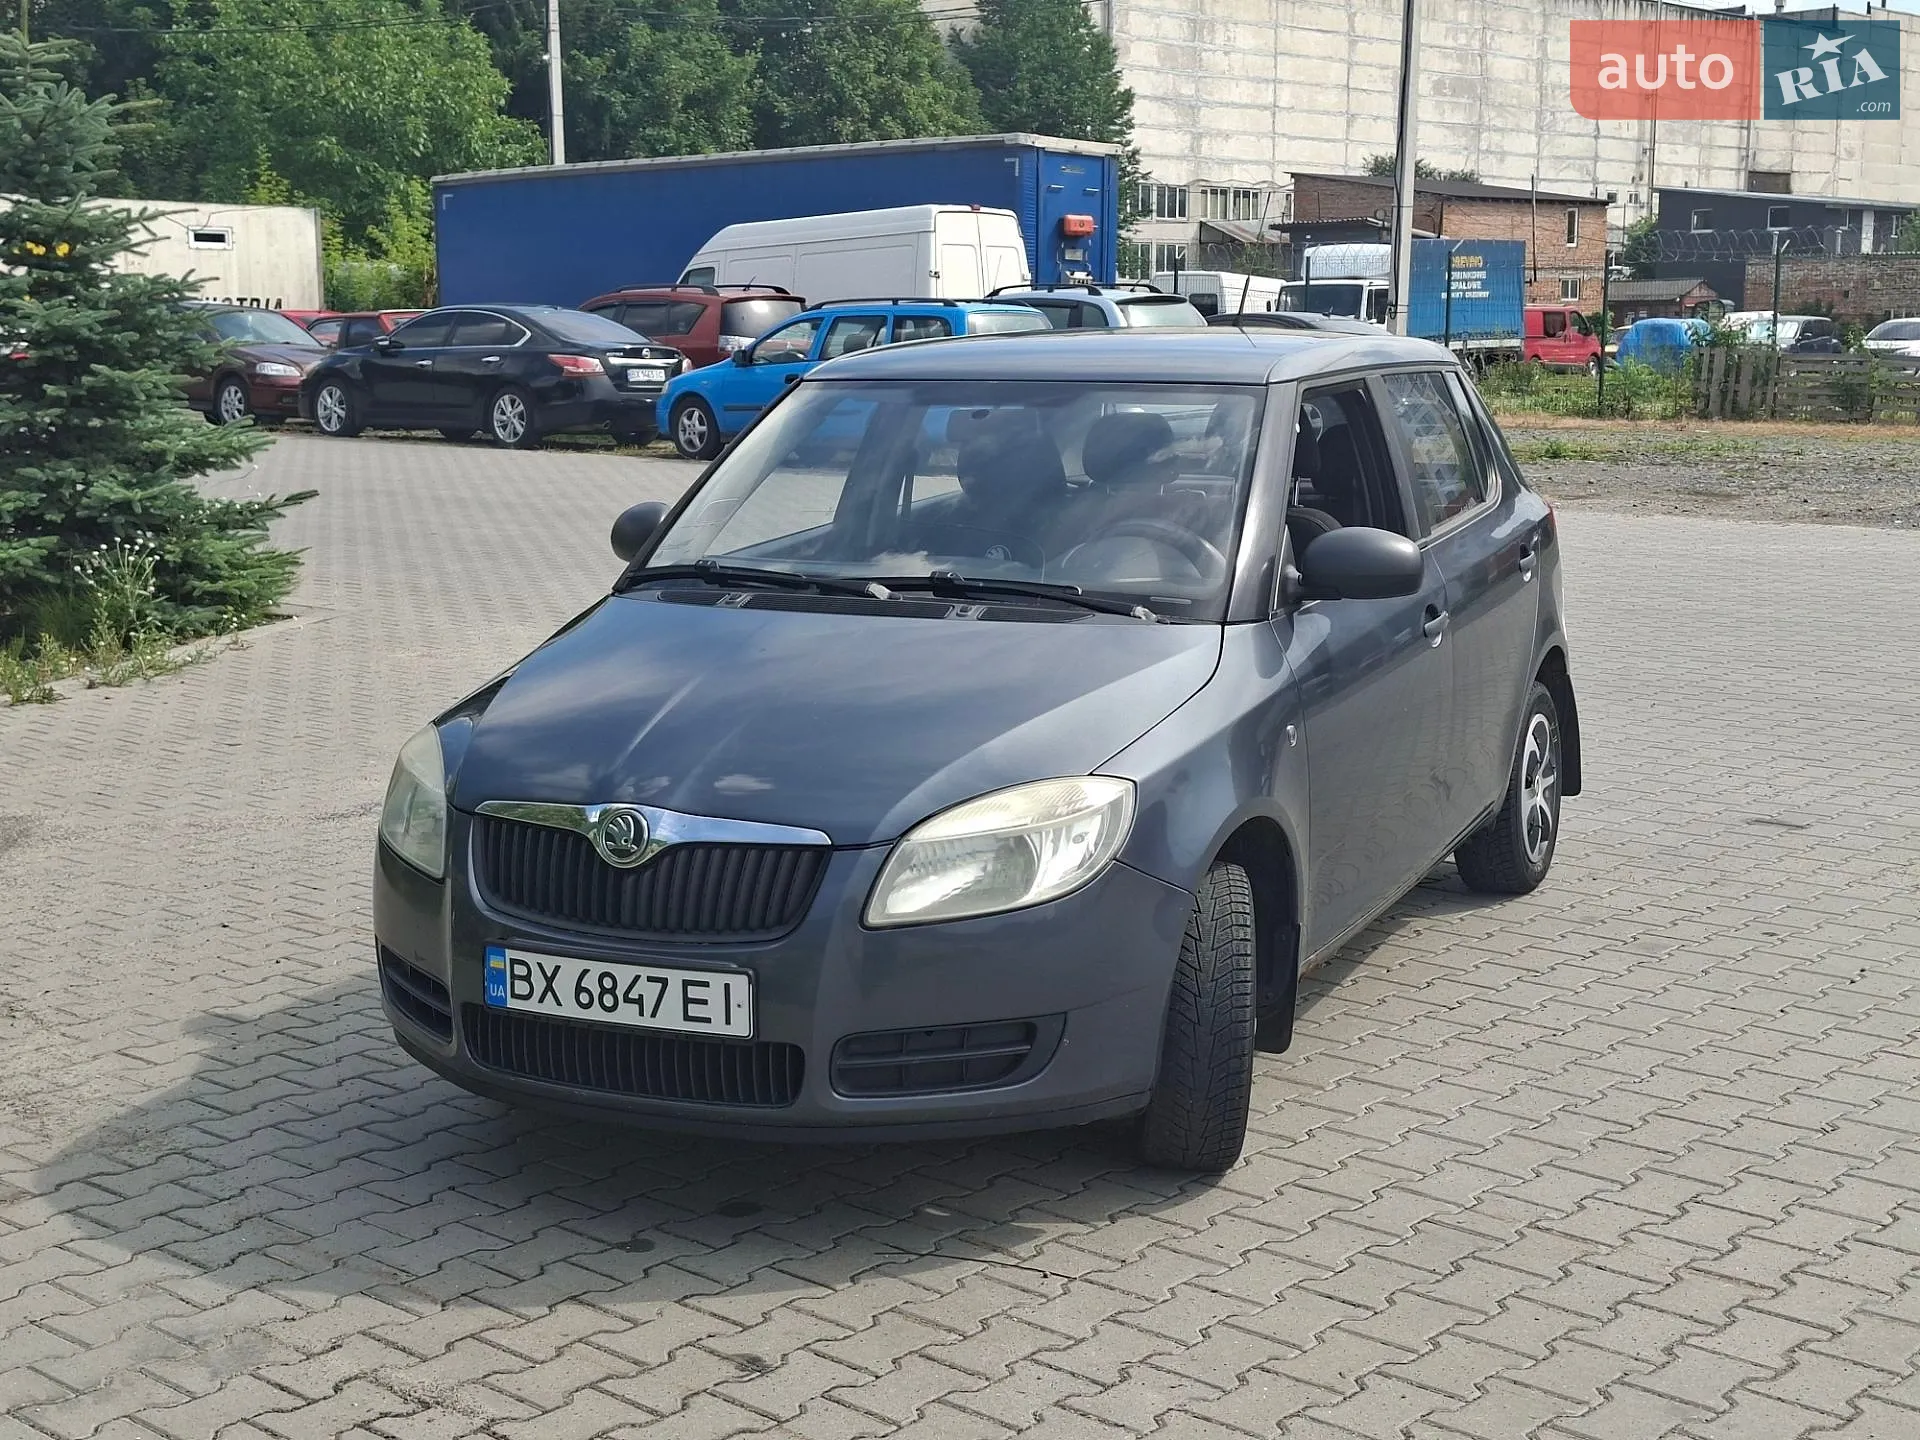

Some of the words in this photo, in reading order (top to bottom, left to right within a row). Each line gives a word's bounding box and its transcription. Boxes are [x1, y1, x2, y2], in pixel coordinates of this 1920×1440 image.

[490, 983, 506, 999] UA
[509, 957, 563, 1007] BX
[574, 968, 669, 1019] 6847
[682, 978, 732, 1026] EI
